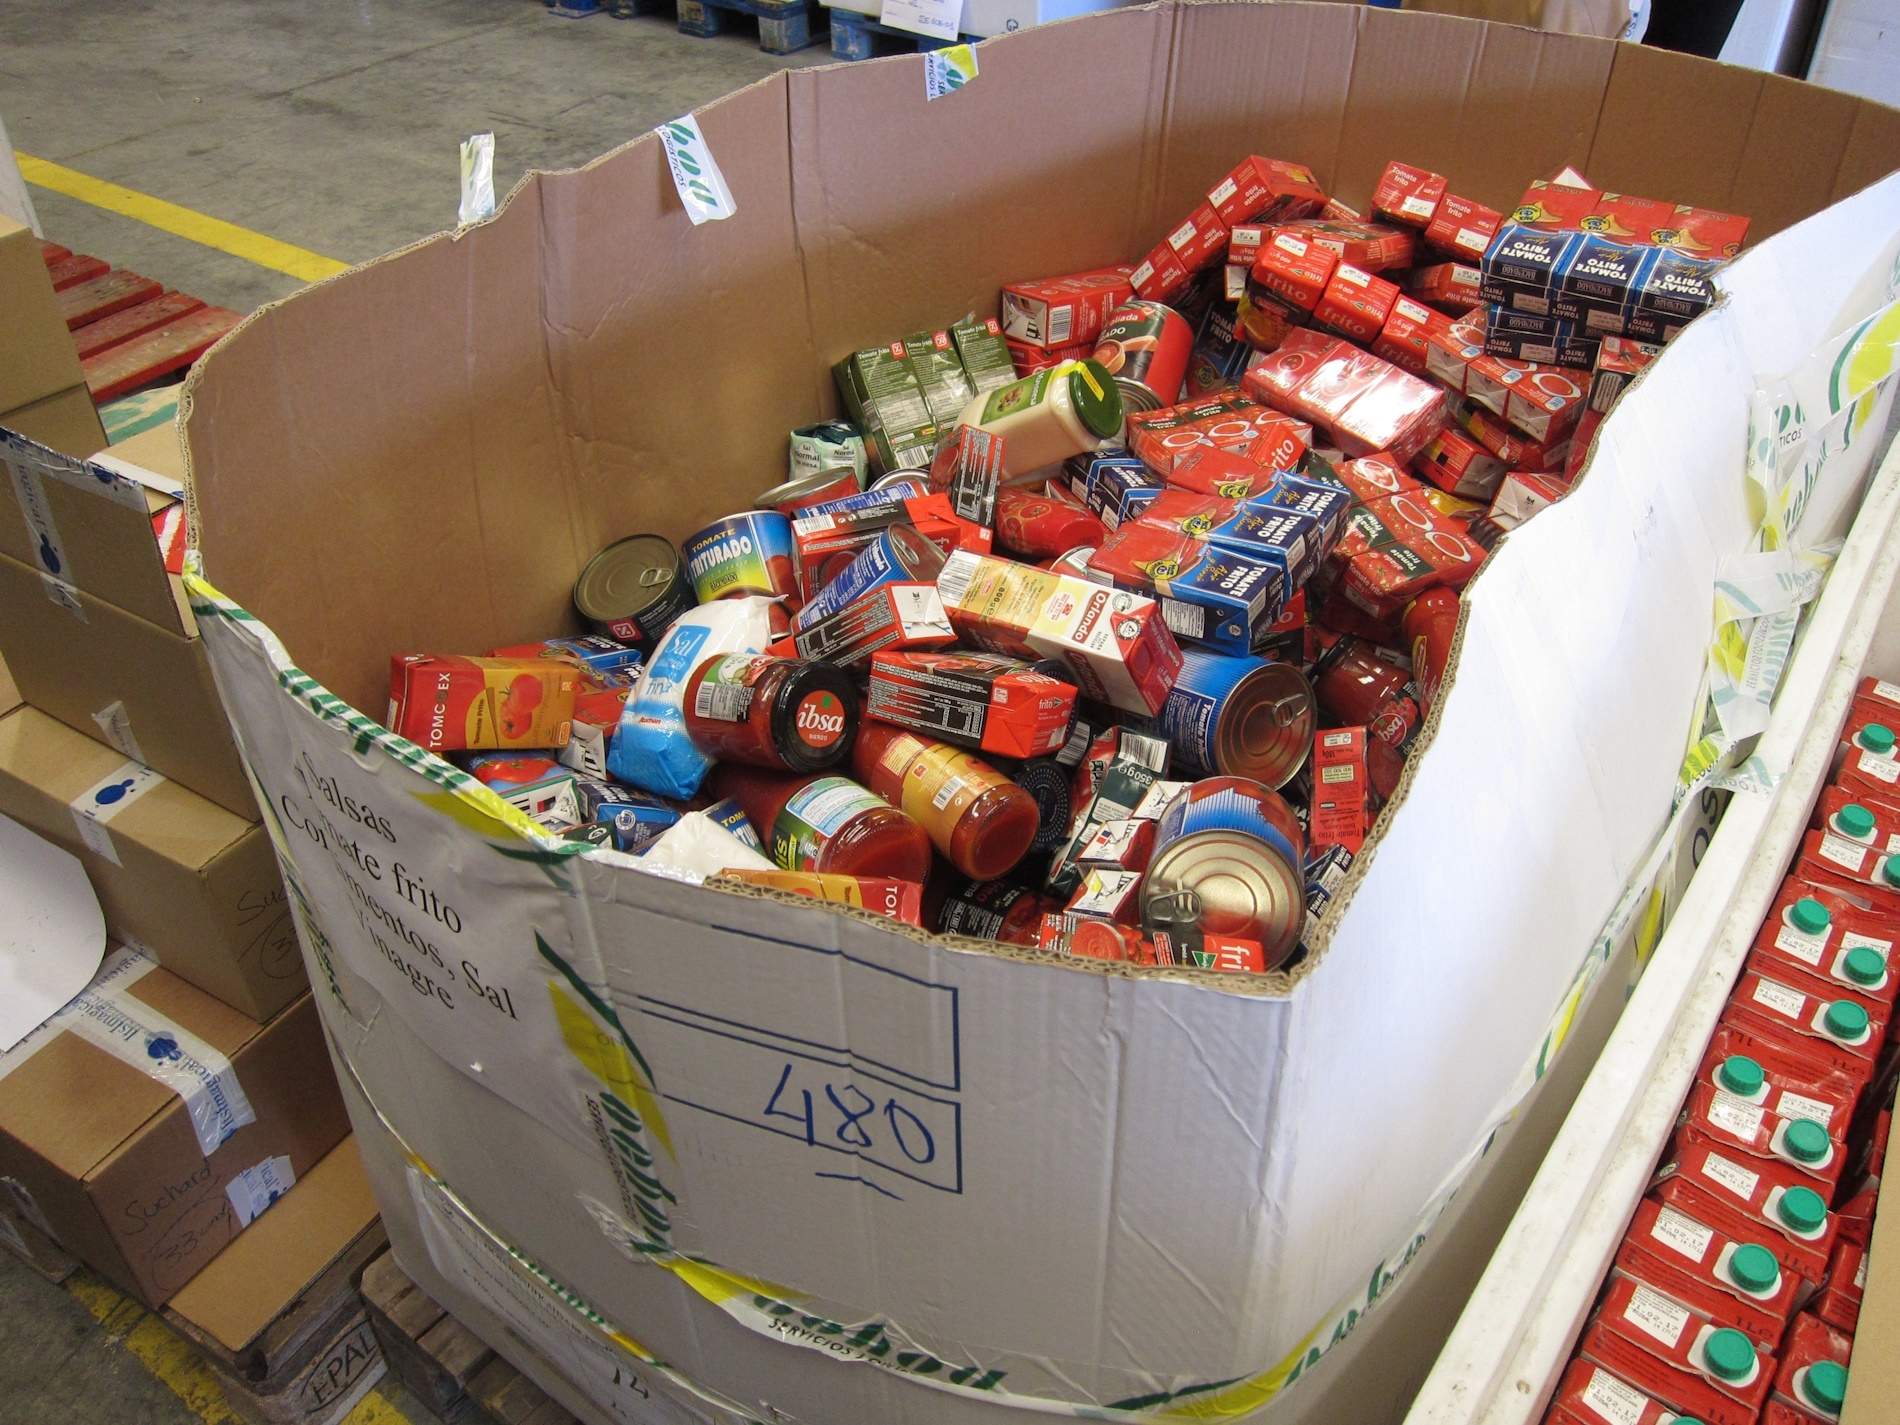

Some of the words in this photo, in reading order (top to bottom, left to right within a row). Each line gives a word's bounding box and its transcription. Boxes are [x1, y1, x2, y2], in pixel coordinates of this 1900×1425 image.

[1445, 198, 1472, 214] Tomate
[1447, 208, 1463, 218] frito
[1501, 247, 1552, 263] TOMATE
[1514, 241, 1550, 251] FRITO
[1575, 263, 1628, 280] TOMATE
[1587, 258, 1625, 271] FRITO
[1266, 272, 1307, 301] frito
[1653, 279, 1706, 296] TOMATE
[1665, 274, 1703, 287] FRITO
[1211, 311, 1235, 333] TOMA
[1211, 324, 1232, 342] FRITO
[1324, 306, 1366, 335] frito
[1270, 438, 1294, 470] rito
[1257, 515, 1284, 538] FRITO
[1268, 515, 1302, 545] TOMATE
[692, 528, 737, 553] TOMATE
[690, 535, 752, 578] TRITURADO
[1390, 549, 1416, 571] Tomate
[1404, 550, 1421, 564] frito
[1220, 565, 1249, 588] FRITO
[1229, 565, 1267, 597] TOMATE
[1075, 591, 1108, 642] Orlando
[798, 703, 844, 733] ibsa
[1378, 716, 1404, 743] bsa
[391, 861, 462, 934] frito
[461, 960, 520, 1022] Sal
[764, 1064, 936, 1164] 480
[768, 1316, 853, 1356] SERVICIOS
[311, 1330, 378, 1403] EPAL
